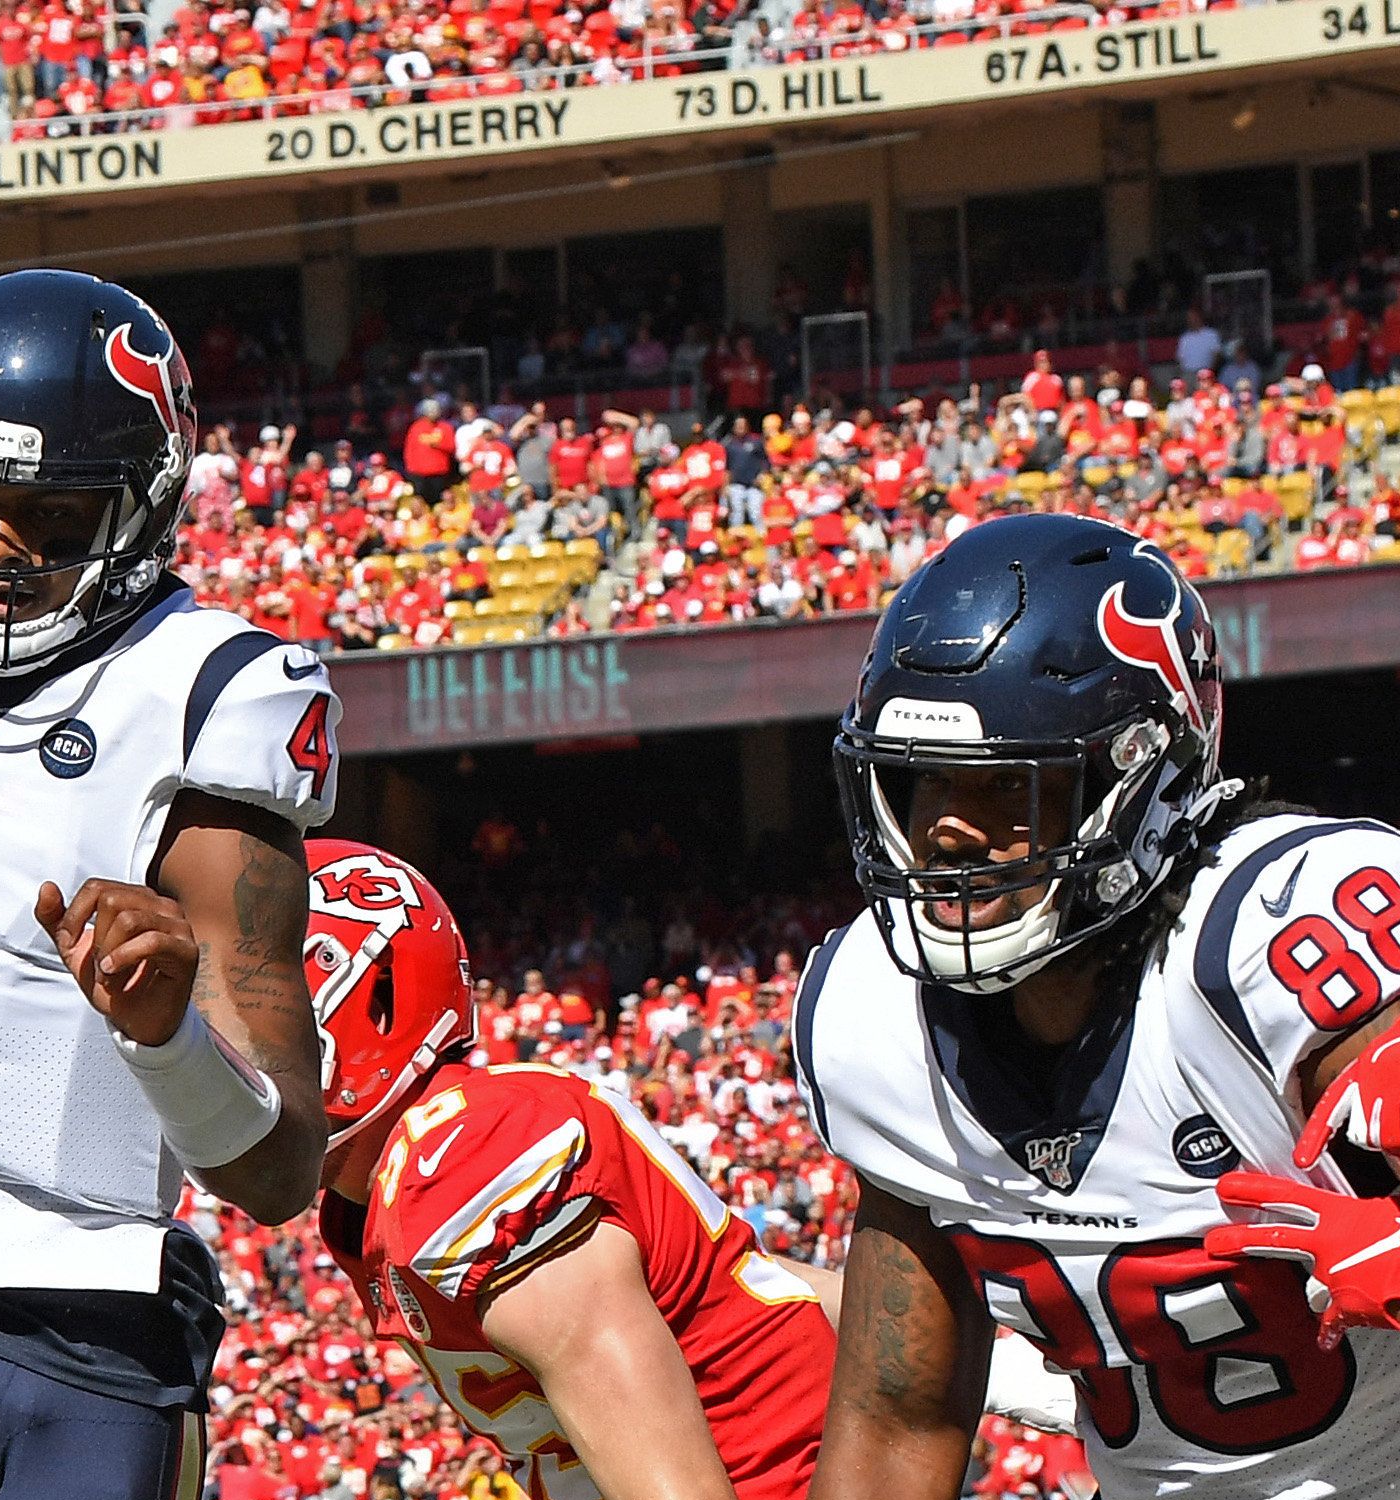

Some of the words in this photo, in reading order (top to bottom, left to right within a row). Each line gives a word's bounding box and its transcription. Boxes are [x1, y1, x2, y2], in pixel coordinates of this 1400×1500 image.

[1322, 5, 1370, 42] 34
[984, 48, 1028, 85] 67
[1094, 22, 1220, 75] STILL
[674, 86, 717, 120] 73
[730, 77, 770, 117] D.
[781, 66, 884, 112] HILL
[266, 129, 314, 164] 20
[328, 121, 368, 161] D.
[378, 98, 570, 155] CHERRY
[893, 709, 963, 723] TEXANS
[285, 691, 334, 803] 4
[313, 867, 406, 911] KC
[1022, 1210, 1139, 1229] TEXANS
